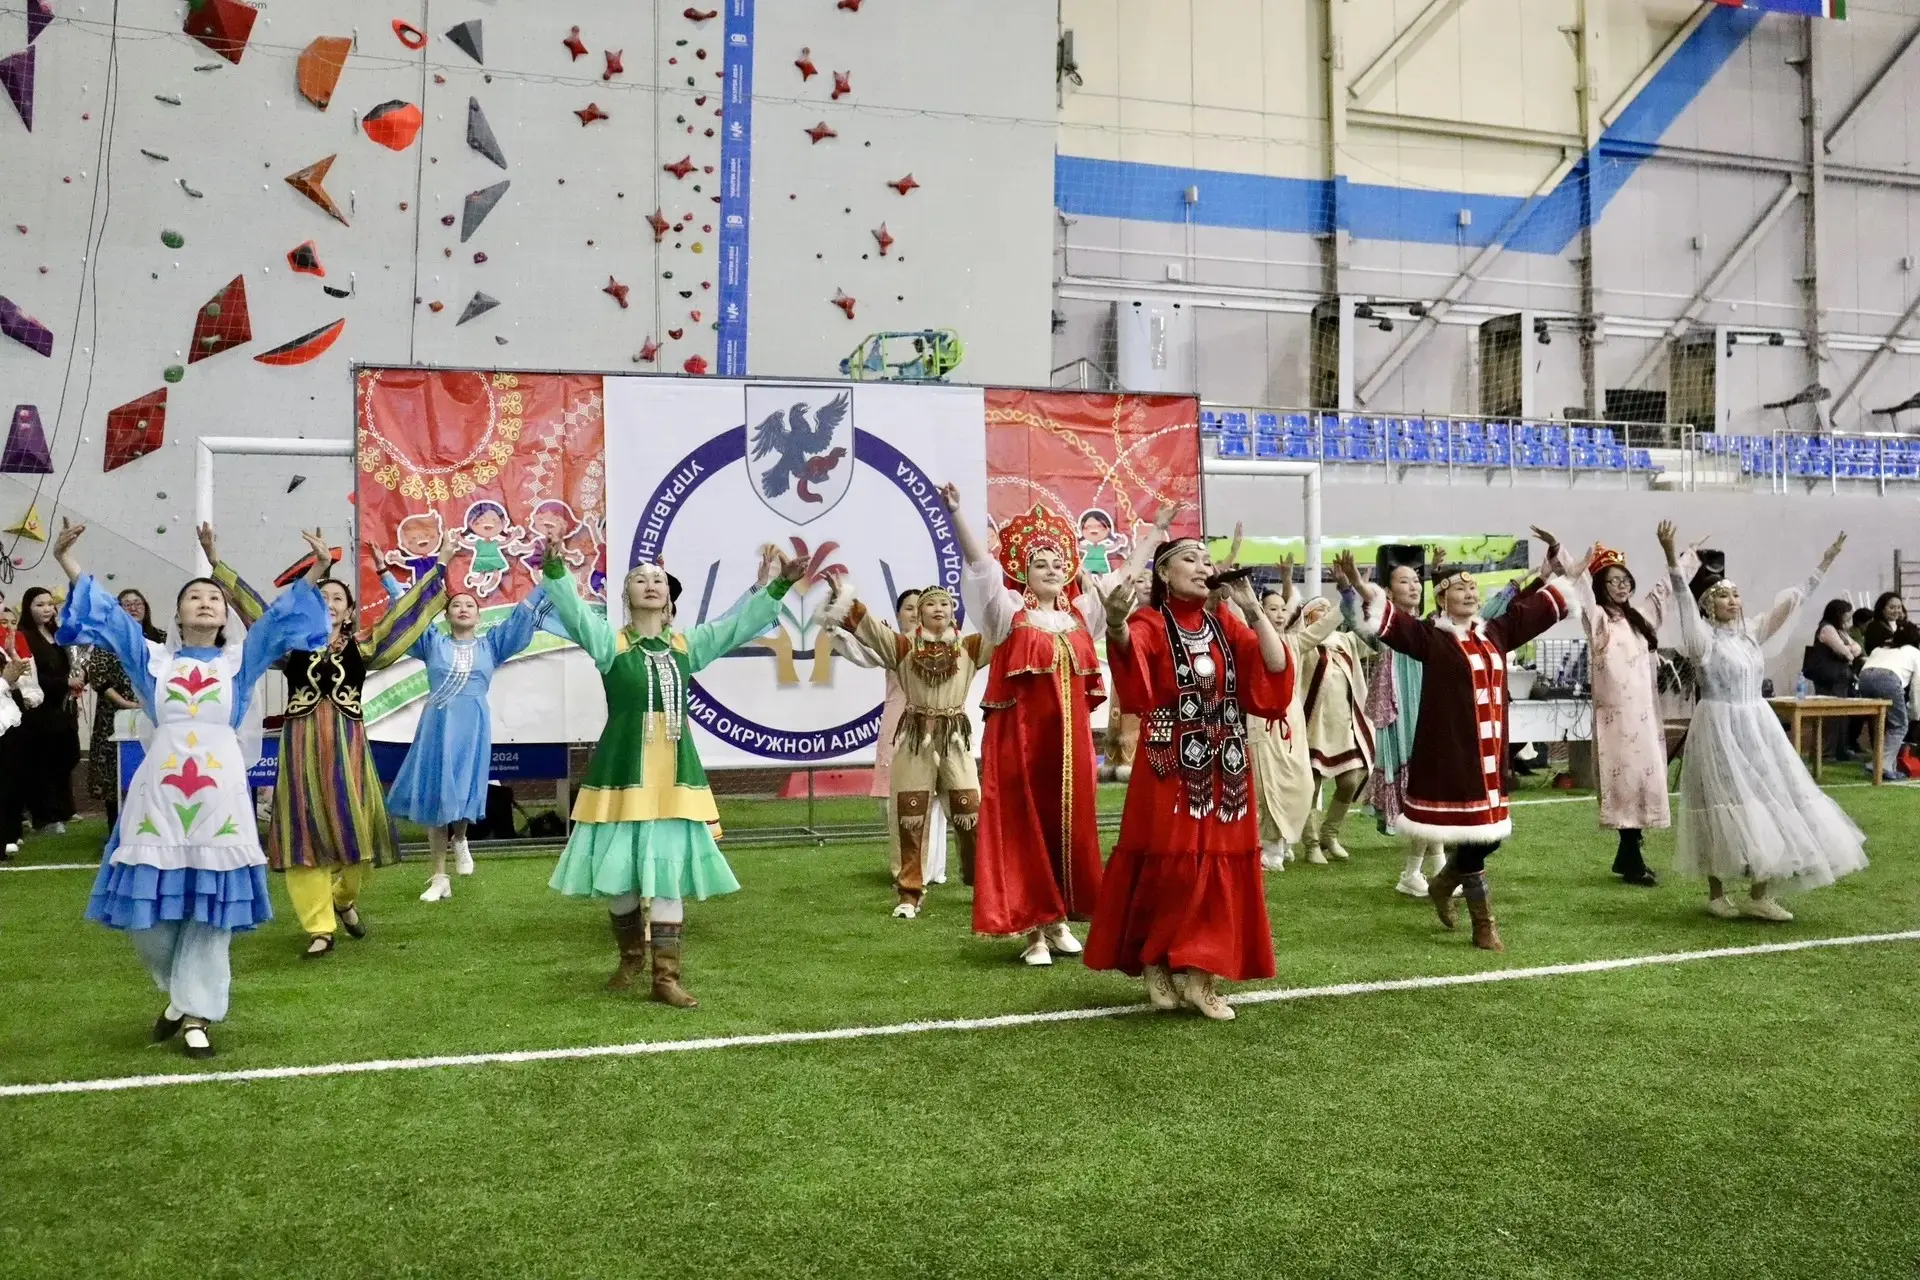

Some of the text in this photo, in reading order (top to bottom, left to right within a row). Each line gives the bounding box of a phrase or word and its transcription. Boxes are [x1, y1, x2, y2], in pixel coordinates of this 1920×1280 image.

[638, 460, 962, 754] УПРАВЛЕНИ НИЯ ОКРУЖНОЙ АДМИ ОРОДА ЯКУТСКА
[492, 752, 519, 761] 2024
